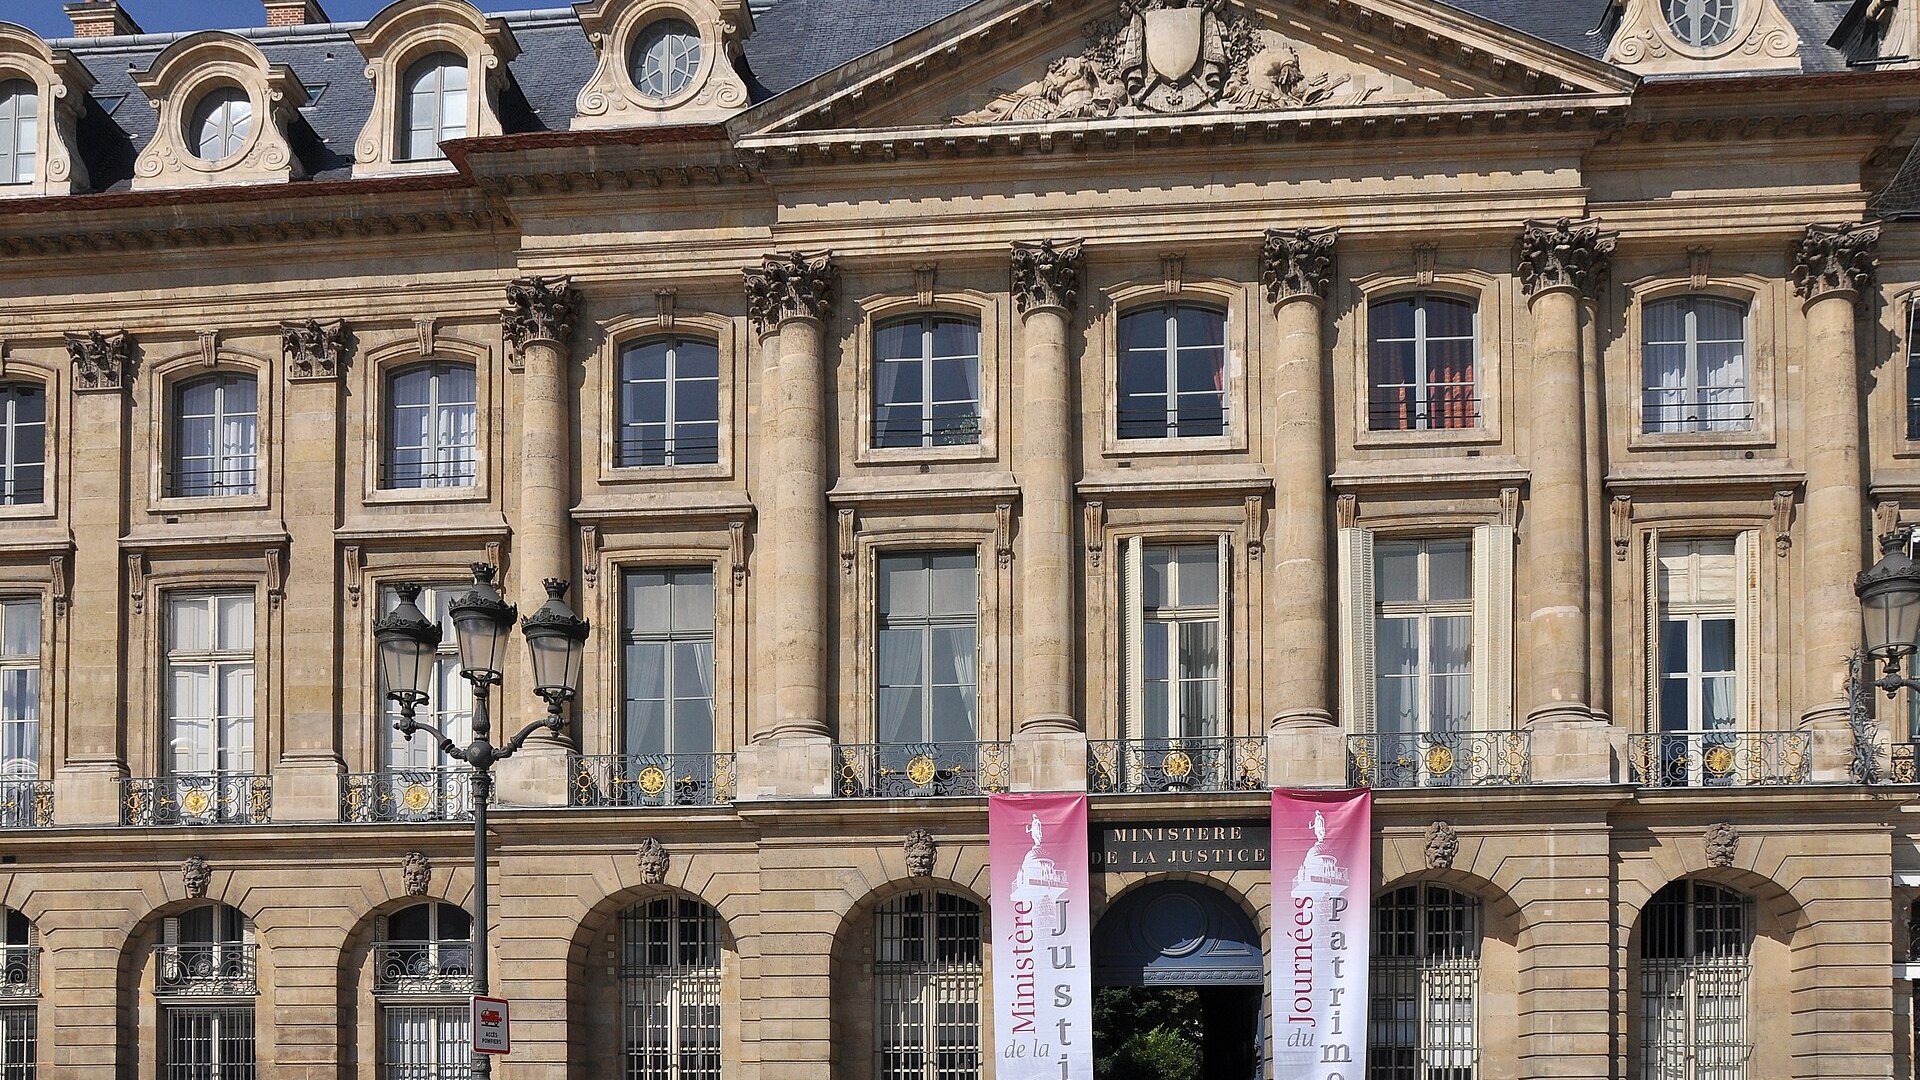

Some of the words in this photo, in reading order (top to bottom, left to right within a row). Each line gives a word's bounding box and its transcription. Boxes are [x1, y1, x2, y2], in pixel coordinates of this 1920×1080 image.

[1113, 826, 1243, 842] MINISTERE
[1091, 851, 1119, 865] DE
[1131, 850, 1157, 864] LA
[1167, 848, 1267, 864] JUSTICE
[1008, 900, 1036, 1035] Ministère
[1286, 895, 1317, 1028] Journées
[1286, 1027, 1315, 1048] du
[1004, 1038, 1026, 1059] de
[1032, 1038, 1050, 1058] la
